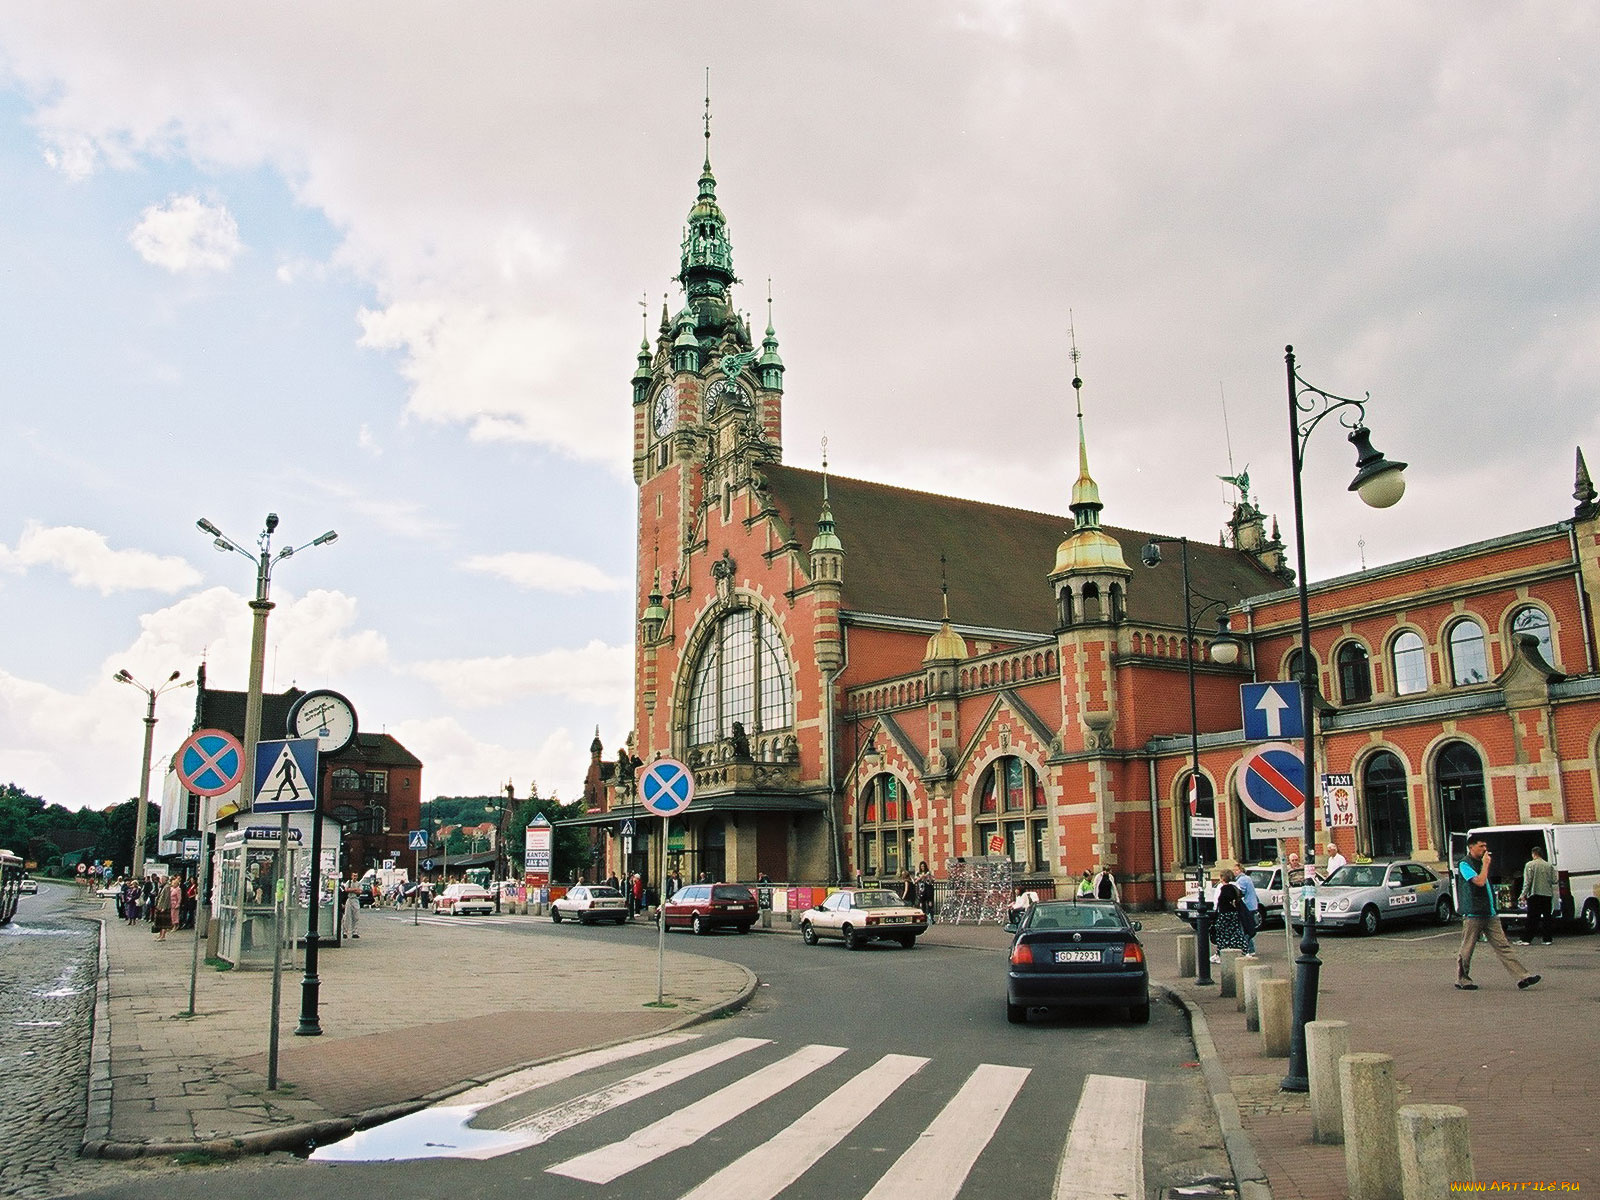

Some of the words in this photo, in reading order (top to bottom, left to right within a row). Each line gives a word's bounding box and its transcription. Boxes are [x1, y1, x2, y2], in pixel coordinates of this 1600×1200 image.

[1328, 775, 1351, 785] TAXI
[1333, 812, 1354, 825] 91-92
[250, 830, 298, 839] TELEFN
[1060, 951, 1072, 960] GD
[1074, 951, 1099, 960] 72931
